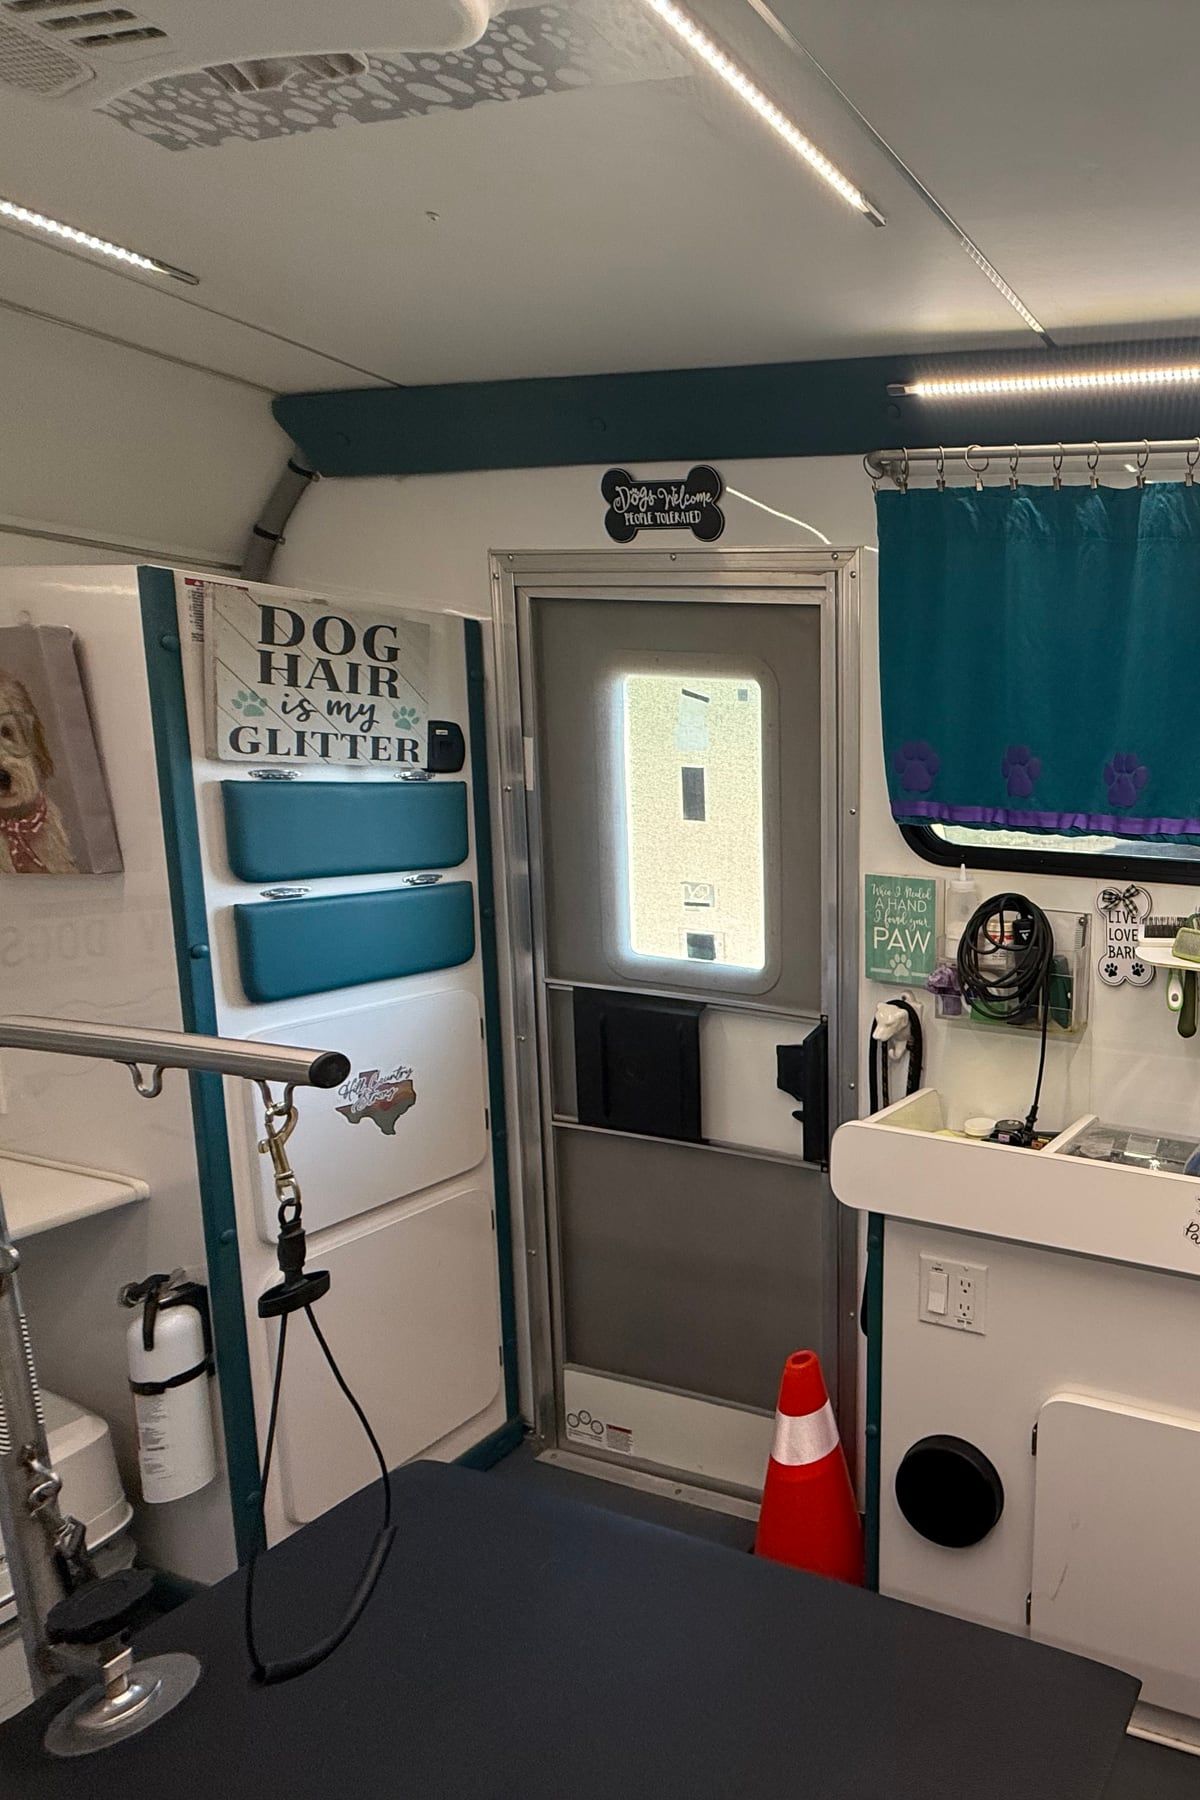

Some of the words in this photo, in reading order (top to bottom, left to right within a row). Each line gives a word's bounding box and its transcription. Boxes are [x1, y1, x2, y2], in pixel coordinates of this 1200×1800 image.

[613, 486, 657, 513] Dogs
[657, 484, 713, 510] Welcome
[624, 511, 654, 526] PEOPLE
[655, 510, 702, 525] TOLERATED
[257, 603, 401, 663] DOG
[257, 649, 401, 699] HAIR
[281, 693, 317, 722] is
[326, 699, 380, 733] my
[229, 725, 421, 763] GLITTER
[875, 897, 884, 909] A
[887, 897, 927, 913] HAND
[1108, 910, 1138, 925] LIVE
[874, 909, 881, 923] I
[885, 908, 908, 929] found
[909, 918, 931, 932] your
[873, 926, 931, 954] PAW
[1108, 928, 1139, 942] LOVE
